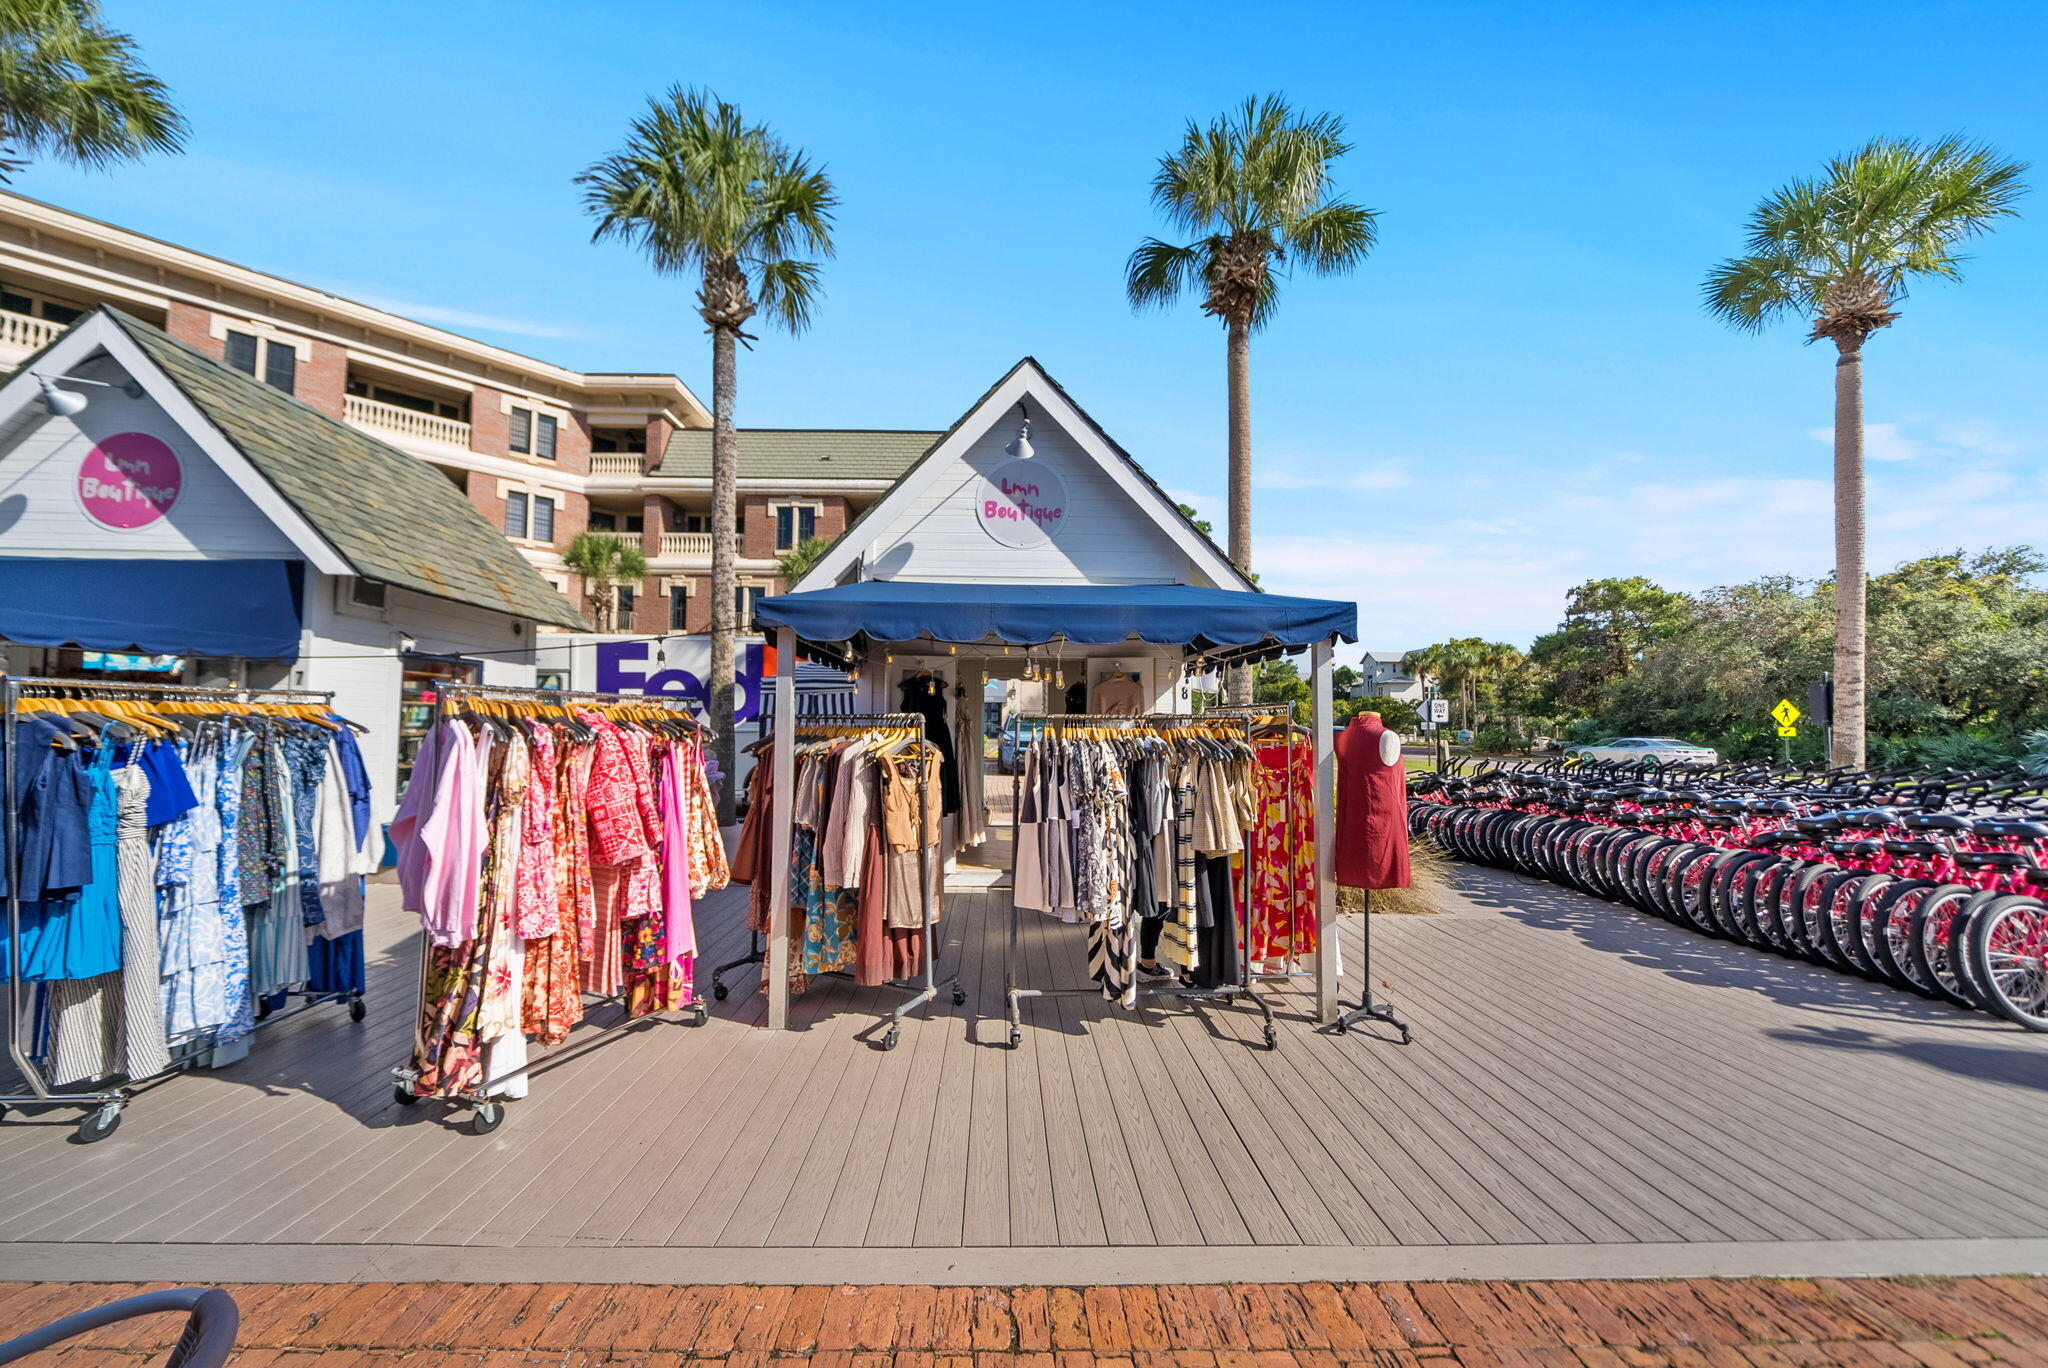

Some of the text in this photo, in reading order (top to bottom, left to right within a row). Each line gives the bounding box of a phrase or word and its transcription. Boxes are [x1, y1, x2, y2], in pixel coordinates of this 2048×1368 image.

[1001, 477, 1040, 497] Lmn
[295, 670, 304, 686] 7
[596, 642, 778, 724] Fed
[1181, 686, 1189, 700] 8
